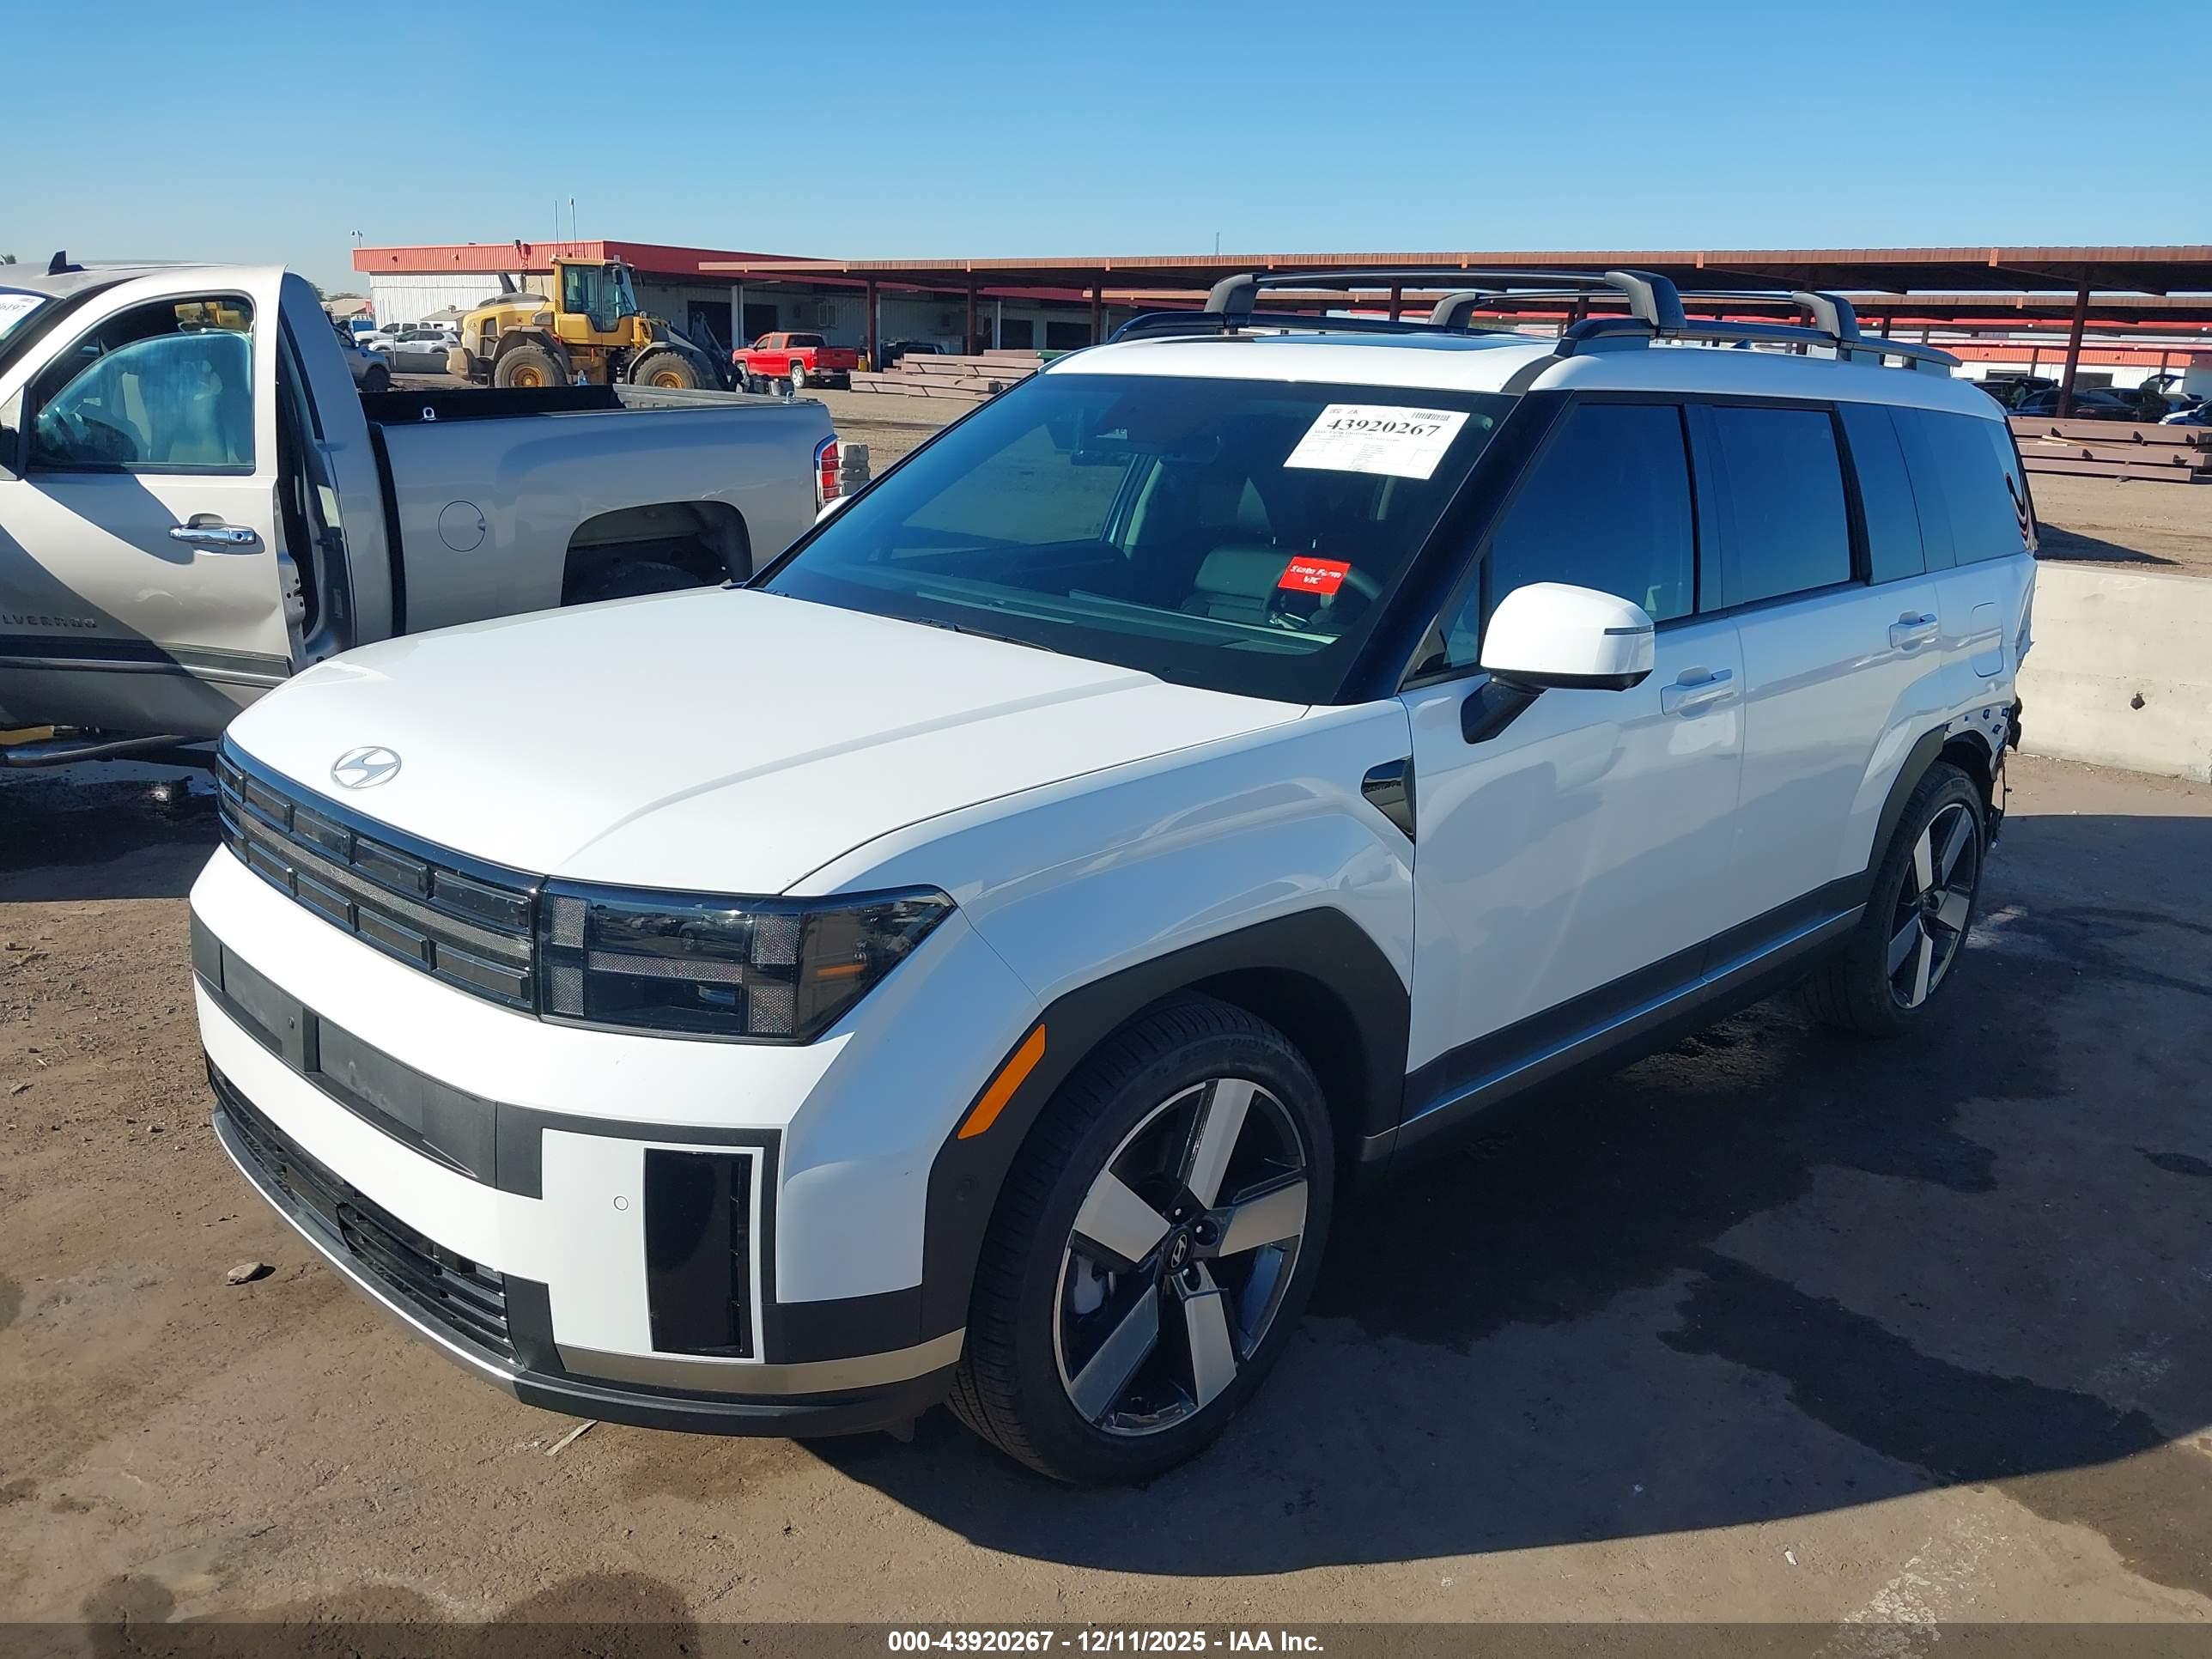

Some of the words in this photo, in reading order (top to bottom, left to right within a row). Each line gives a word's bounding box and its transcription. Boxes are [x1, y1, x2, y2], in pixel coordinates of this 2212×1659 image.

[1327, 417, 1442, 438] 43920267
[1291, 564, 1316, 576] State
[1316, 568, 1342, 579] Farm
